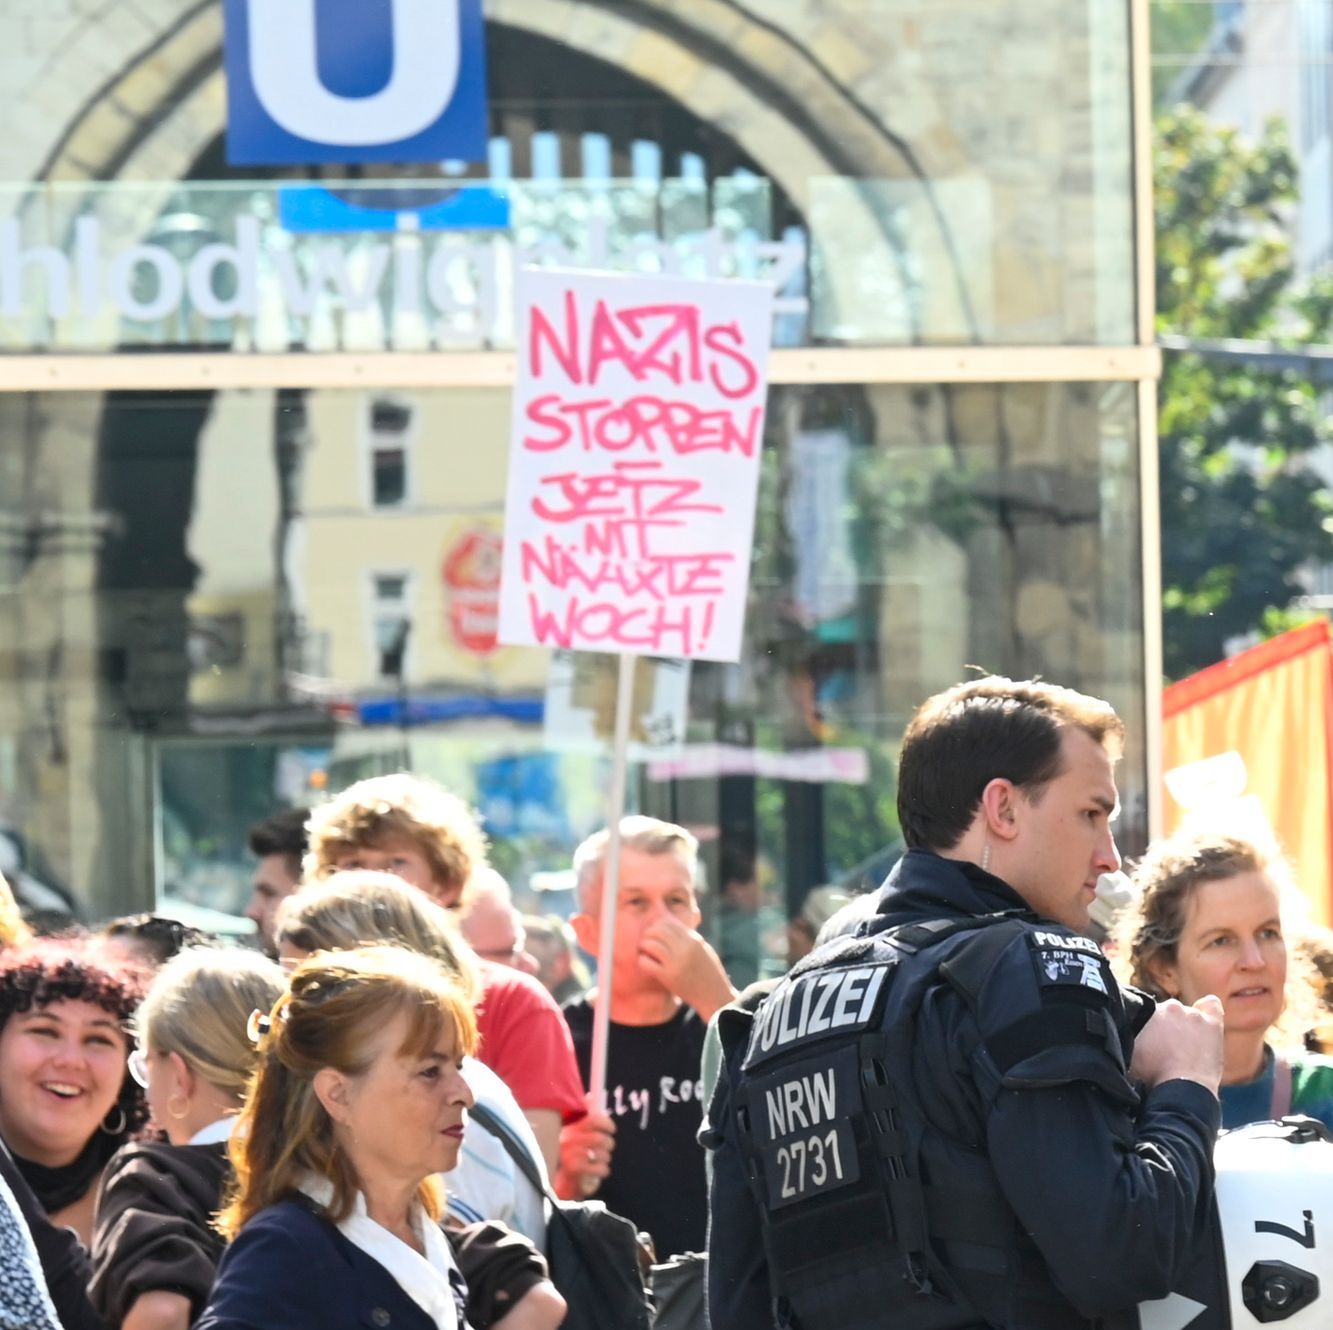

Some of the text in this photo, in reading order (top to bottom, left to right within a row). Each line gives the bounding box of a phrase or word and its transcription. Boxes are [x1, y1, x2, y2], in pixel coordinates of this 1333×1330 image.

[248, 0, 461, 147] U
[529, 288, 759, 400] NAZIS
[524, 392, 763, 458] STOPPEN
[528, 592, 716, 656] WOCH!
[766, 1067, 837, 1141] NRW
[776, 1128, 844, 1199] 2731
[1254, 1210, 1316, 1248] 7
